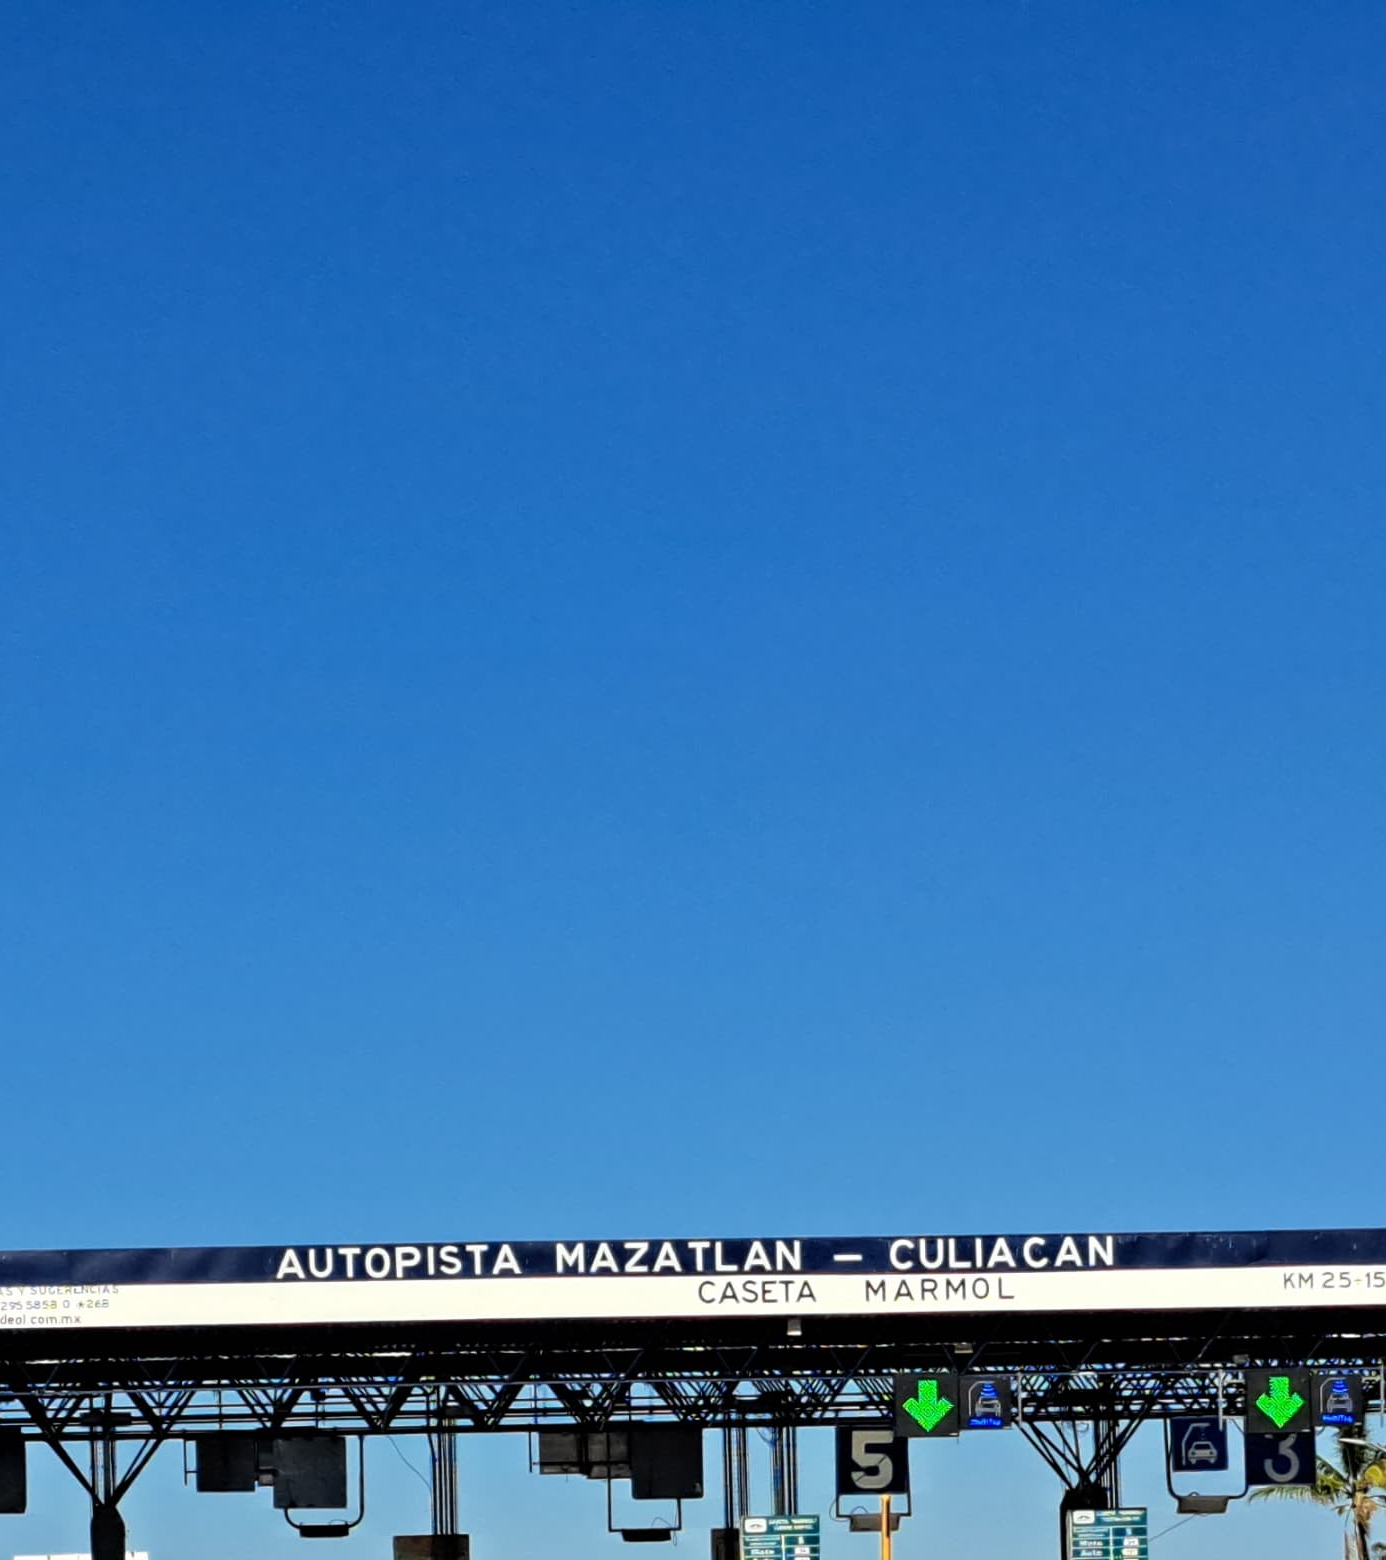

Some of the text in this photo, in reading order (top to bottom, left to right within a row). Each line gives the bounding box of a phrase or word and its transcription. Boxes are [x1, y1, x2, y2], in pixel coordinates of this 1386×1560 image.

[276, 1244, 522, 1280] AUTOPISTA
[556, 1240, 802, 1274] MAZATLAN
[889, 1236, 1115, 1270] CULIACAN
[698, 1276, 1015, 1304] CASETA MARMOL
[1283, 1272, 1314, 1289] KM
[850, 1430, 895, 1490] 5
[1263, 1433, 1300, 1483] 3
